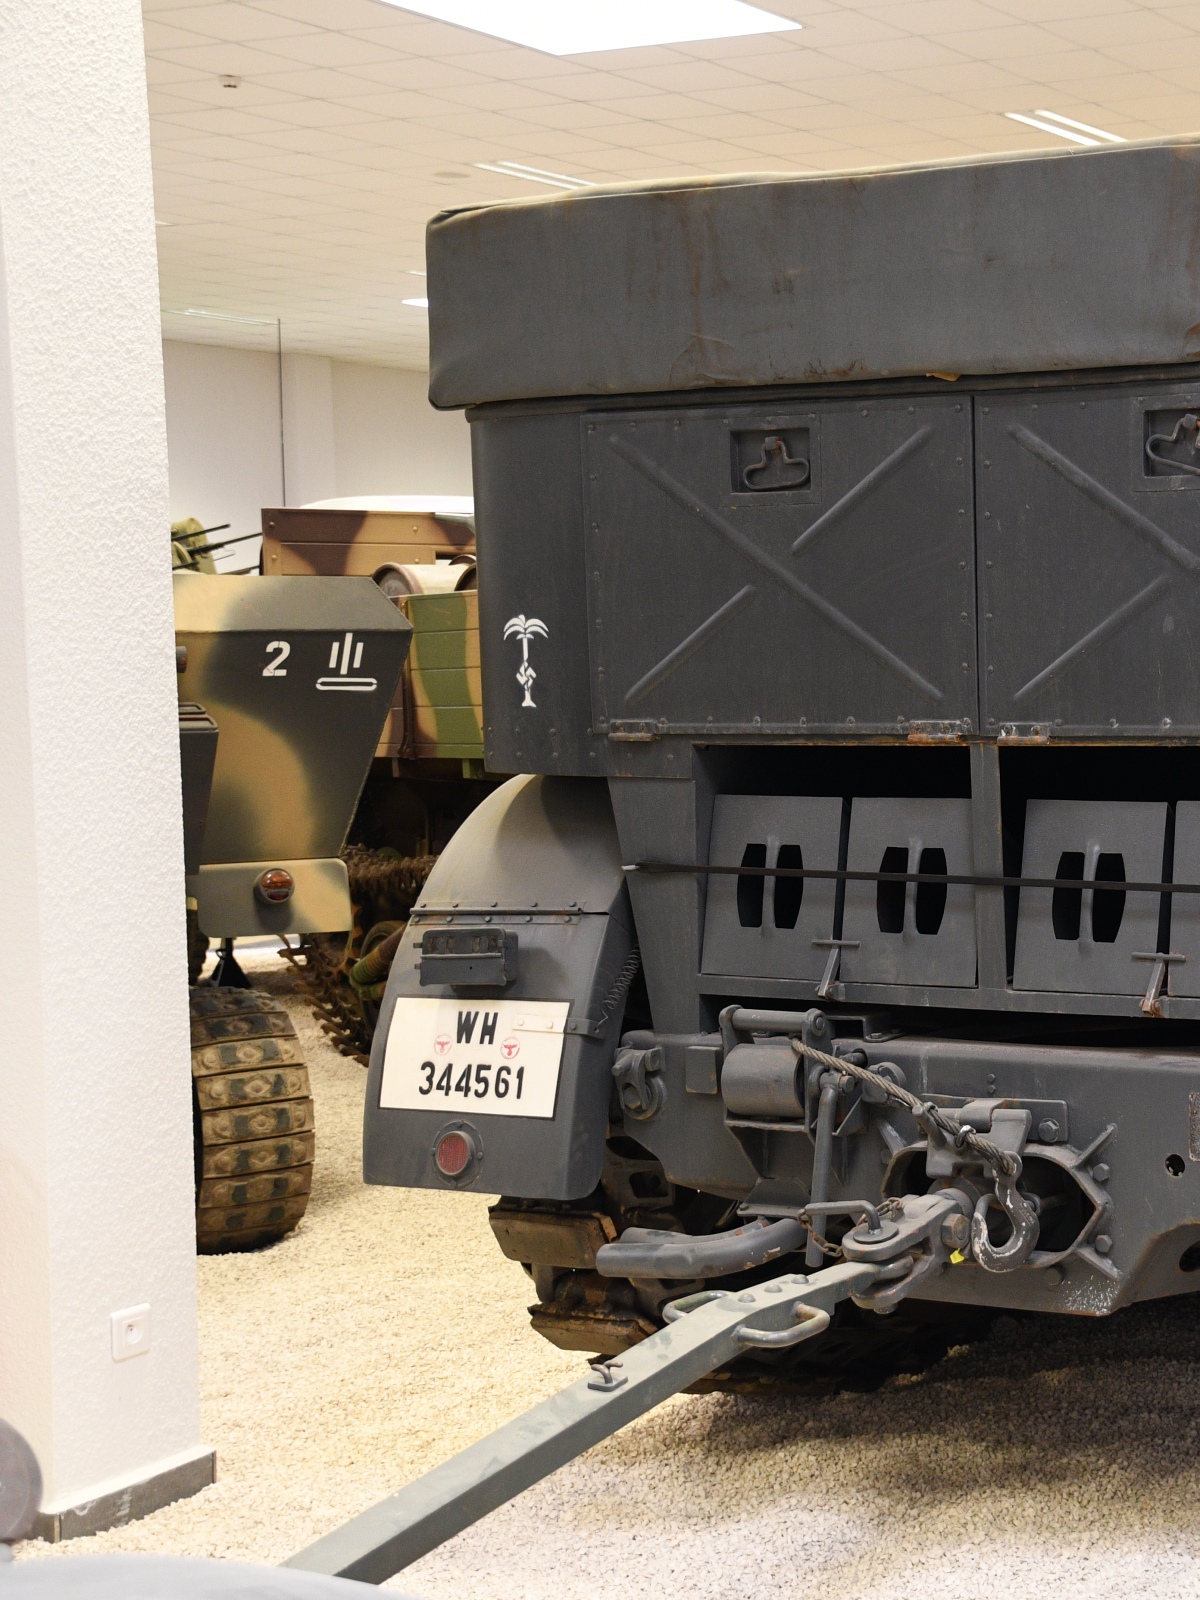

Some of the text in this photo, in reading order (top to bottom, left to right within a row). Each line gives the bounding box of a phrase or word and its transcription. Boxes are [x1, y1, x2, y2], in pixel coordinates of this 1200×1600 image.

[262, 640, 291, 676] 2
[456, 1010, 499, 1045] WH
[418, 1061, 525, 1100] 344561
